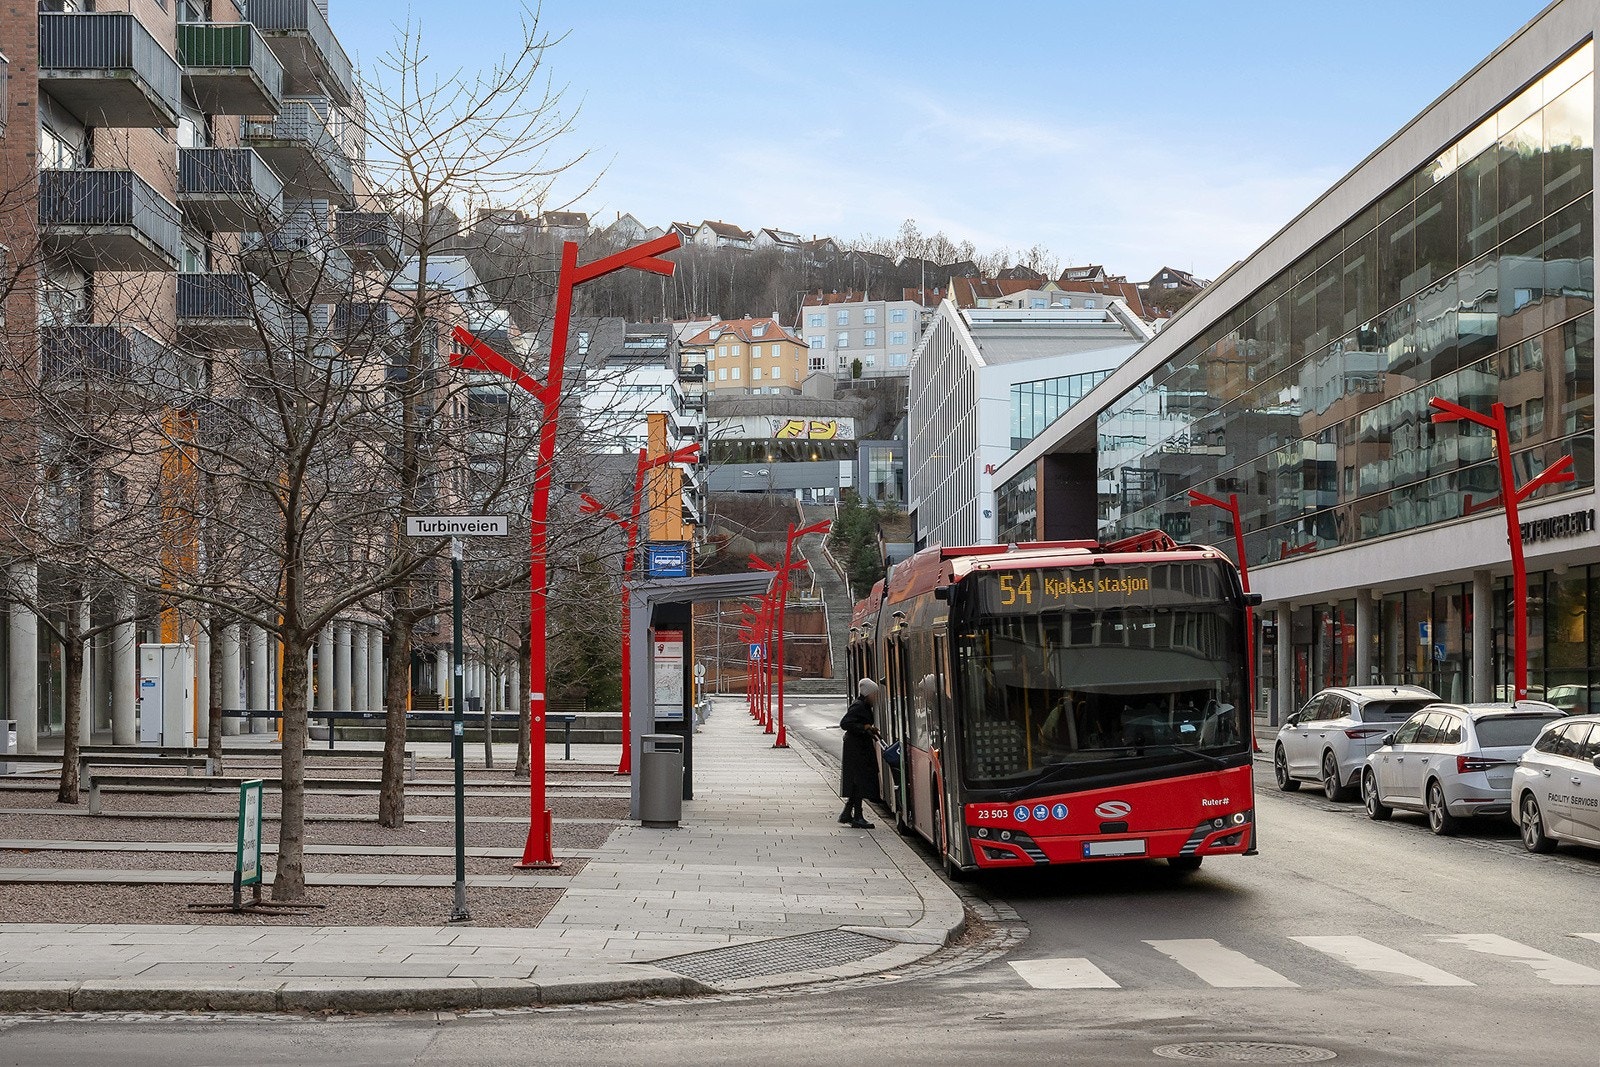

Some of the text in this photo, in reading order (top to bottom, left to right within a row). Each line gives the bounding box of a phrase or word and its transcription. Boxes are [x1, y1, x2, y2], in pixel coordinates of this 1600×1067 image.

[415, 519, 499, 533] Turbinveien
[1000, 574, 1149, 605] 54 Kjelsås stasjon
[1201, 797, 1230, 807] Ruter#
[1548, 792, 1570, 804] FACILITY
[1570, 795, 1598, 808] SERVICES
[978, 808, 1009, 820] 23 503
